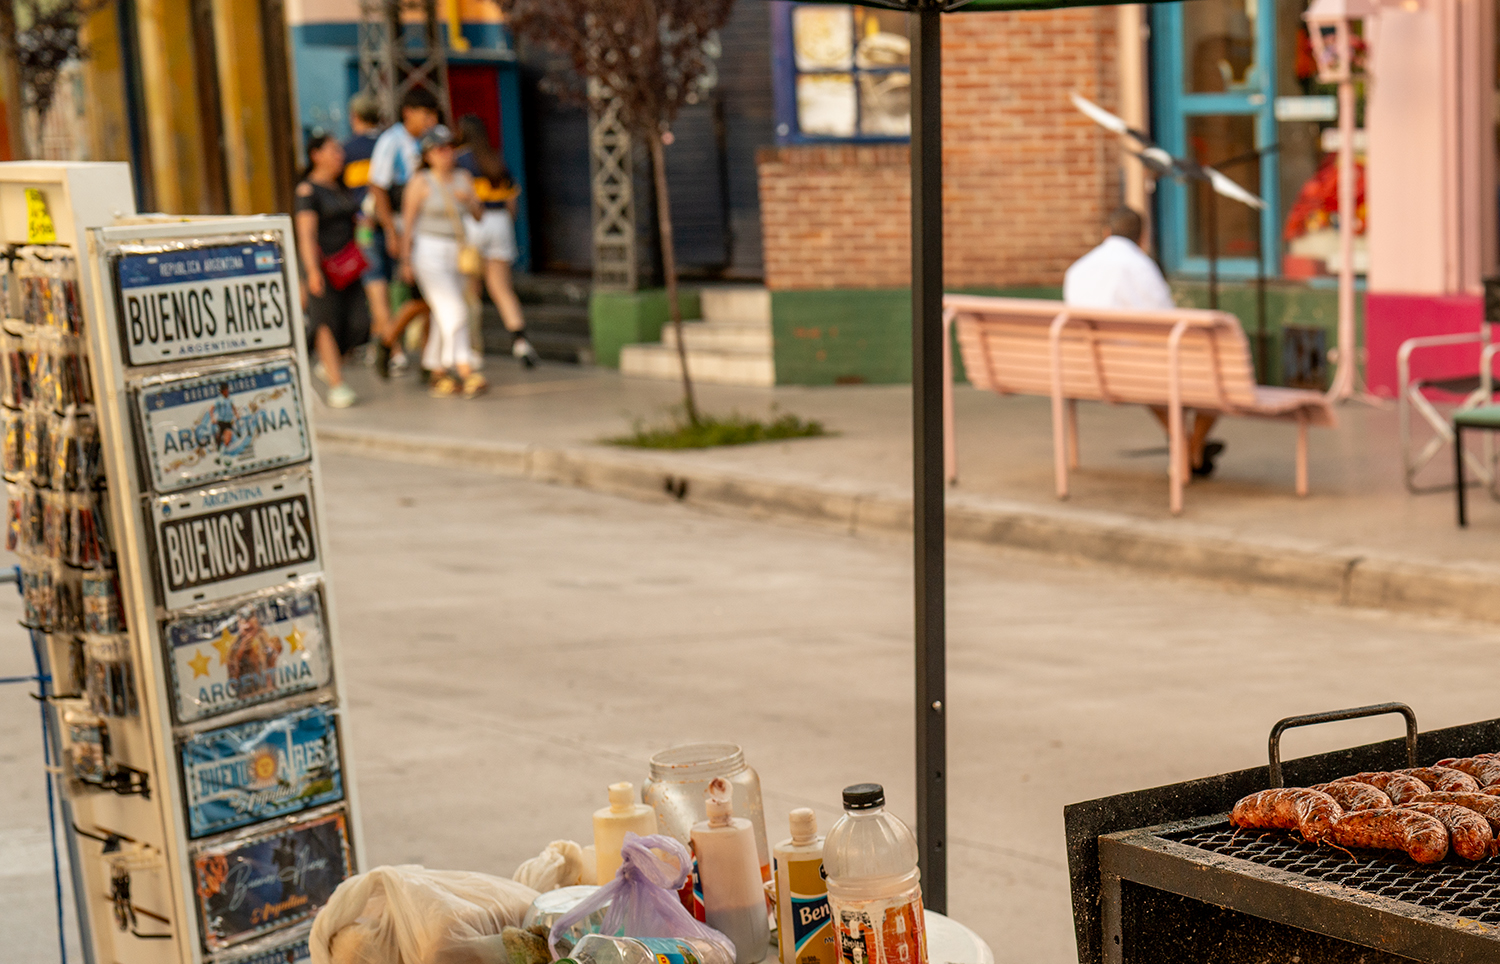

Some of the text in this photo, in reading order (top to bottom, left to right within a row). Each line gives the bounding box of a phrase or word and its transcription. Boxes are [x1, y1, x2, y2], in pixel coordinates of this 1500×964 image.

[204, 255, 245, 273] ARGENTINA
[128, 280, 284, 346] BUENOS AIRES
[178, 338, 248, 355] ARGENTINA
[163, 407, 292, 455] ARGNTINA
[202, 486, 263, 508] ARGENTINA
[165, 499, 311, 586] BUENOS AIRES
[199, 659, 312, 705] ARGENTINA
